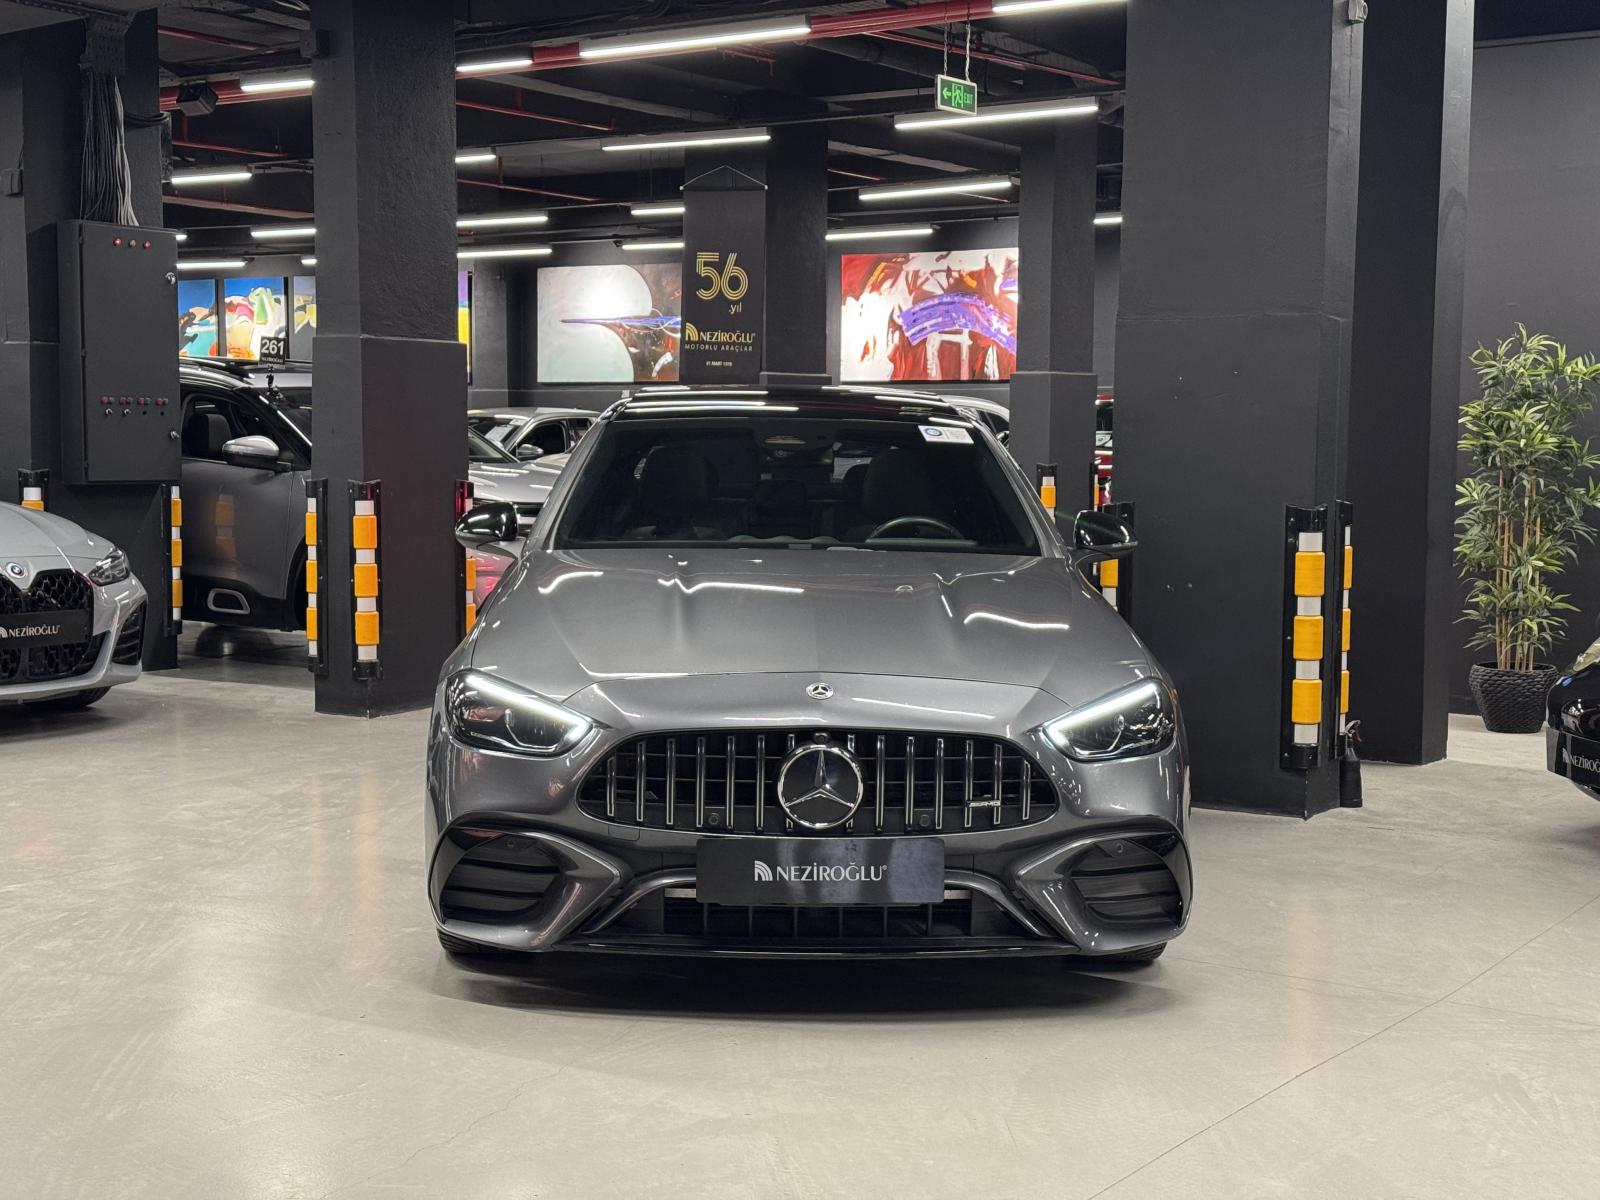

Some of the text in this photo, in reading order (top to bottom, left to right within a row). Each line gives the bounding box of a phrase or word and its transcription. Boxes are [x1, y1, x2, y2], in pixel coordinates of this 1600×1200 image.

[963, 92, 974, 105] EXIT
[696, 252, 749, 300] 56
[700, 329, 754, 343] NEZİROĞLU
[260, 339, 285, 356] 261
[684, 343, 753, 353] MOTORLU ARAÇLAR
[9, 624, 59, 638] NEZİROĞLU
[776, 862, 883, 881] NEZİROĞLU
